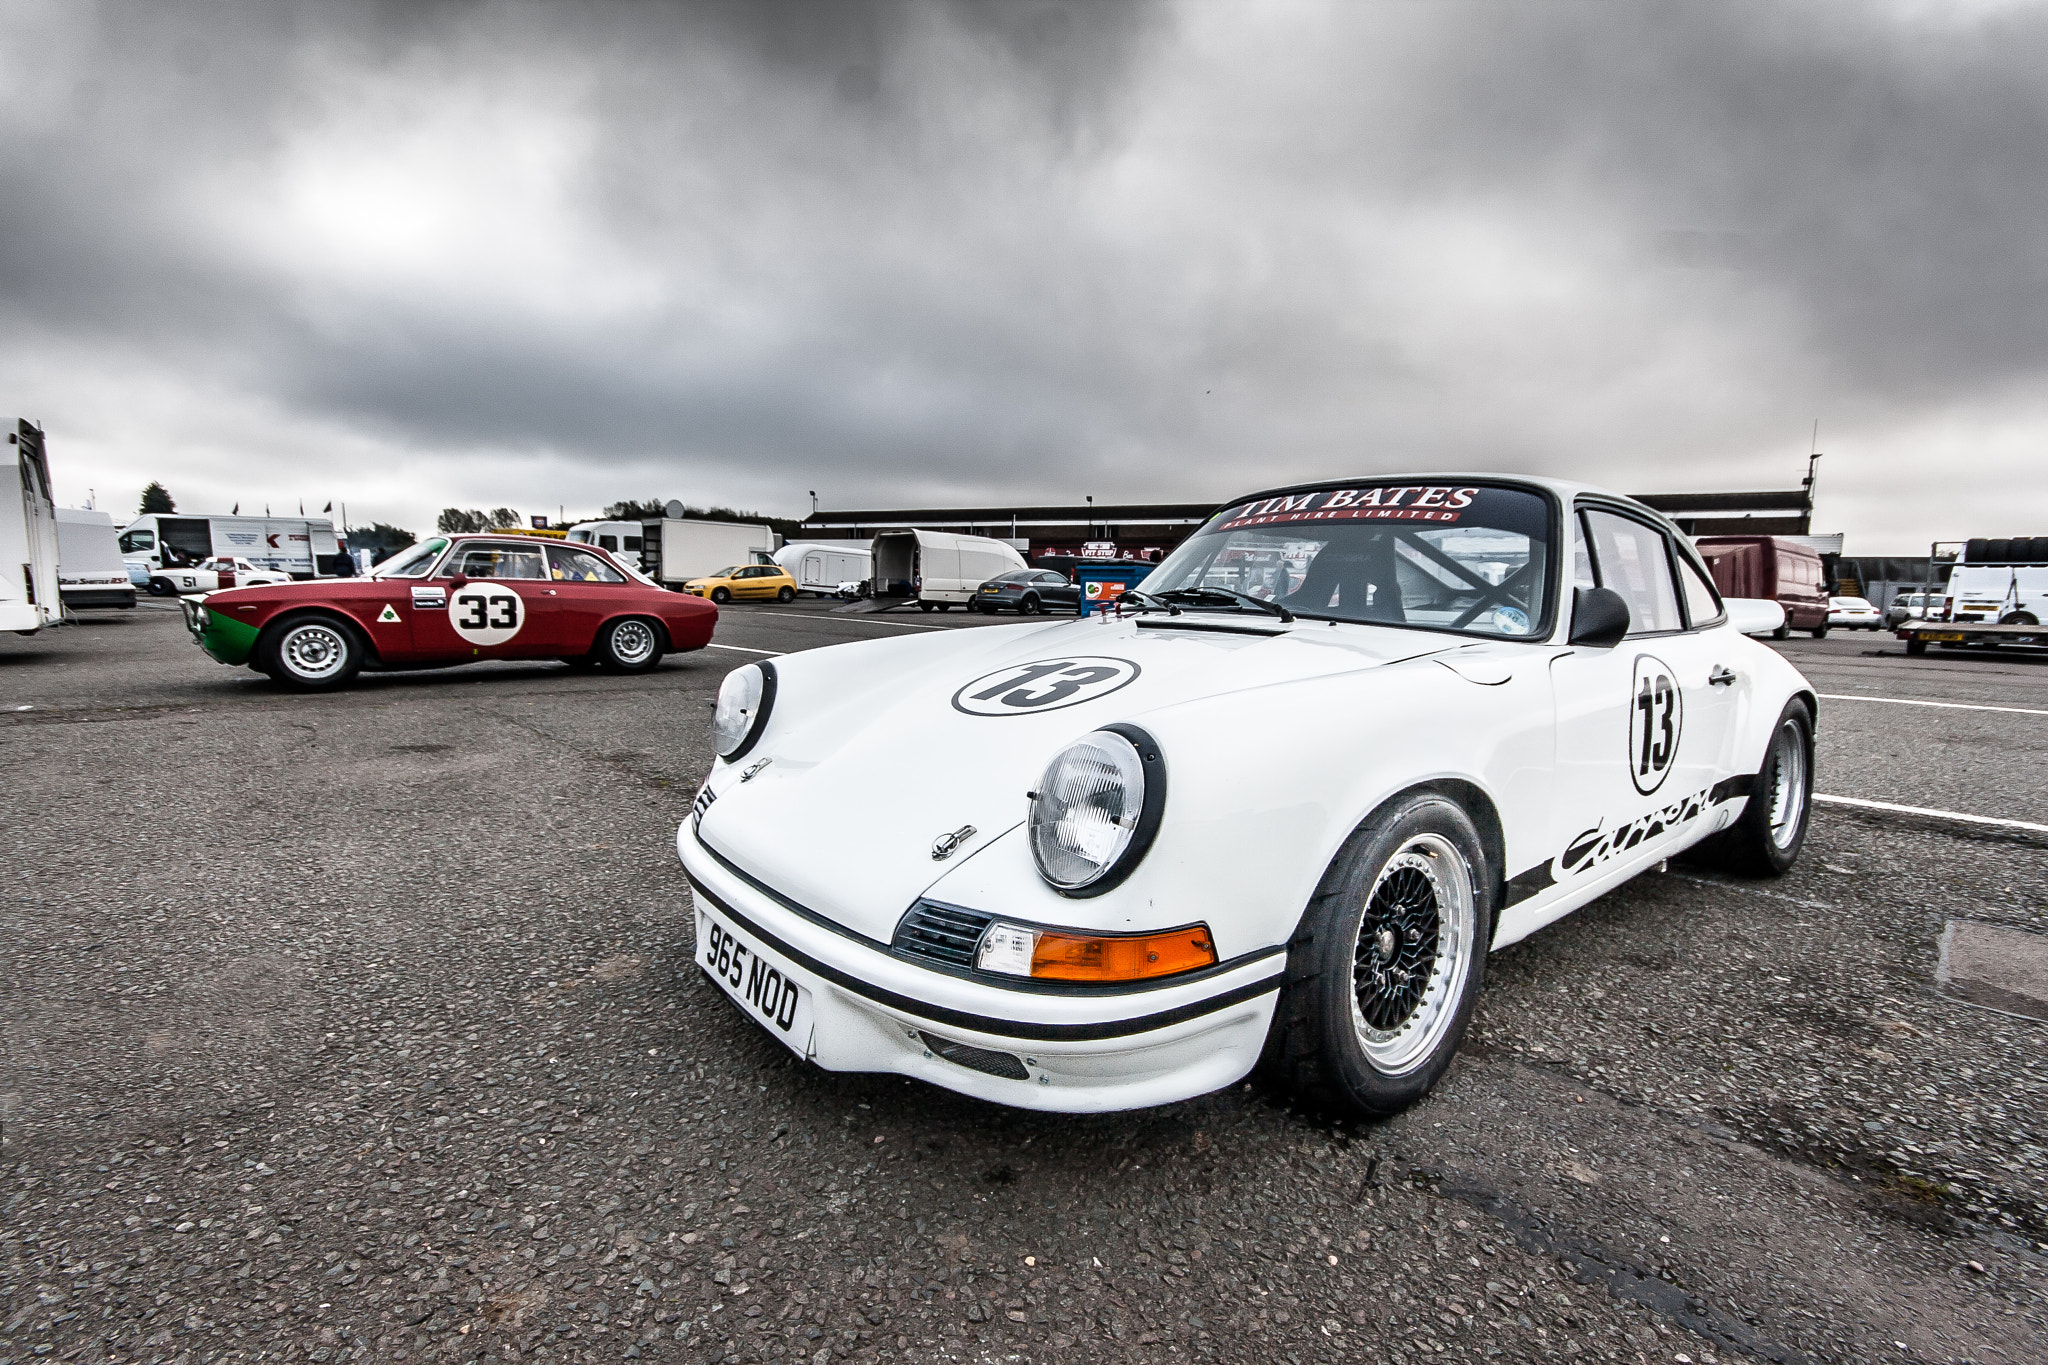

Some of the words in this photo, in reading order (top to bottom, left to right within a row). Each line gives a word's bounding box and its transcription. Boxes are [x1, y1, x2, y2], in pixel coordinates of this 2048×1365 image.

[1223, 515, 1278, 529] PLANT
[1290, 511, 1337, 520] HIRE
[1352, 510, 1453, 521] LIMITED
[1236, 492, 1320, 519] TIM
[1320, 486, 1480, 509] BATES
[183, 576, 197, 587] 51
[458, 595, 518, 630] 33
[968, 661, 1121, 708] 13
[1637, 674, 1675, 777] 13
[706, 922, 748, 989] 965
[745, 954, 799, 1033] NOD
